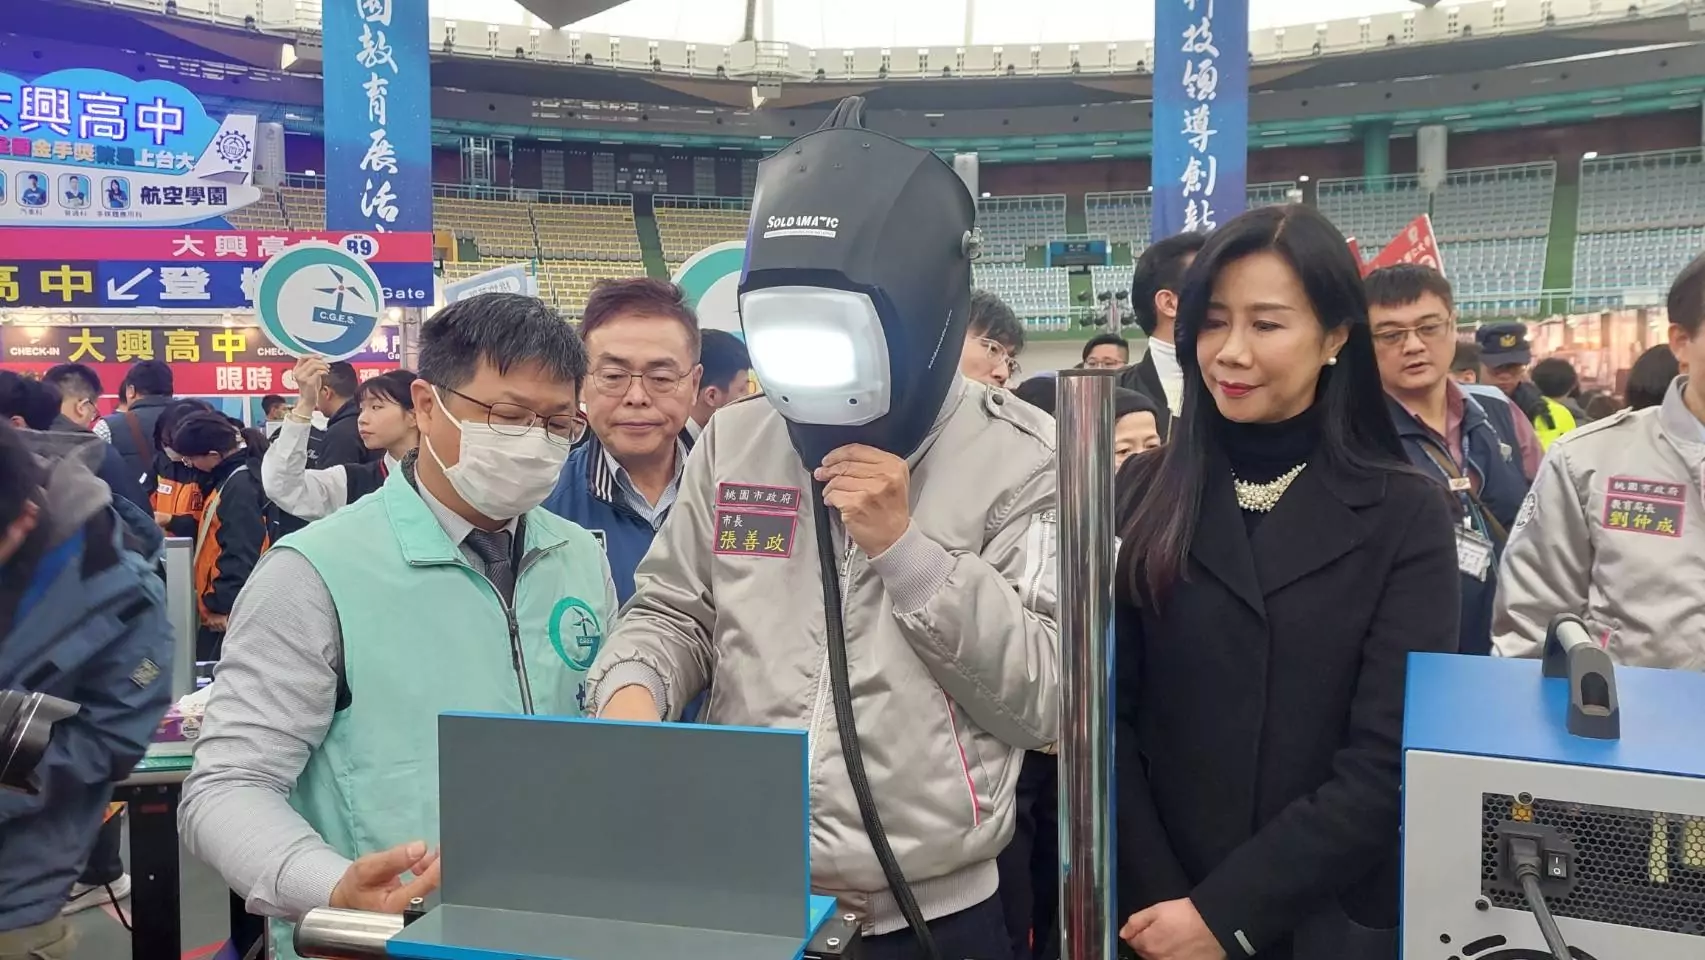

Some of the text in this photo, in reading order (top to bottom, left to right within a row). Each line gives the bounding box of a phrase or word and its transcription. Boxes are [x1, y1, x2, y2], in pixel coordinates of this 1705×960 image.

[356, 0, 398, 233] 園教育展活
[140, 186, 228, 206] 航空學園
[172, 234, 328, 258] 大興高
[383, 287, 425, 299] Gate
[320, 311, 356, 324] C.G.E.S.
[10, 347, 60, 356] CHECK-IN
[68, 328, 247, 363] 大興高中
[257, 347, 290, 356] CHEC
[724, 488, 793, 505] 桃園市政府
[1614, 481, 1679, 496] 桃園市政府
[722, 514, 743, 528] 市長
[1609, 511, 1675, 533] 劉仲成
[720, 529, 785, 552] 張善政
